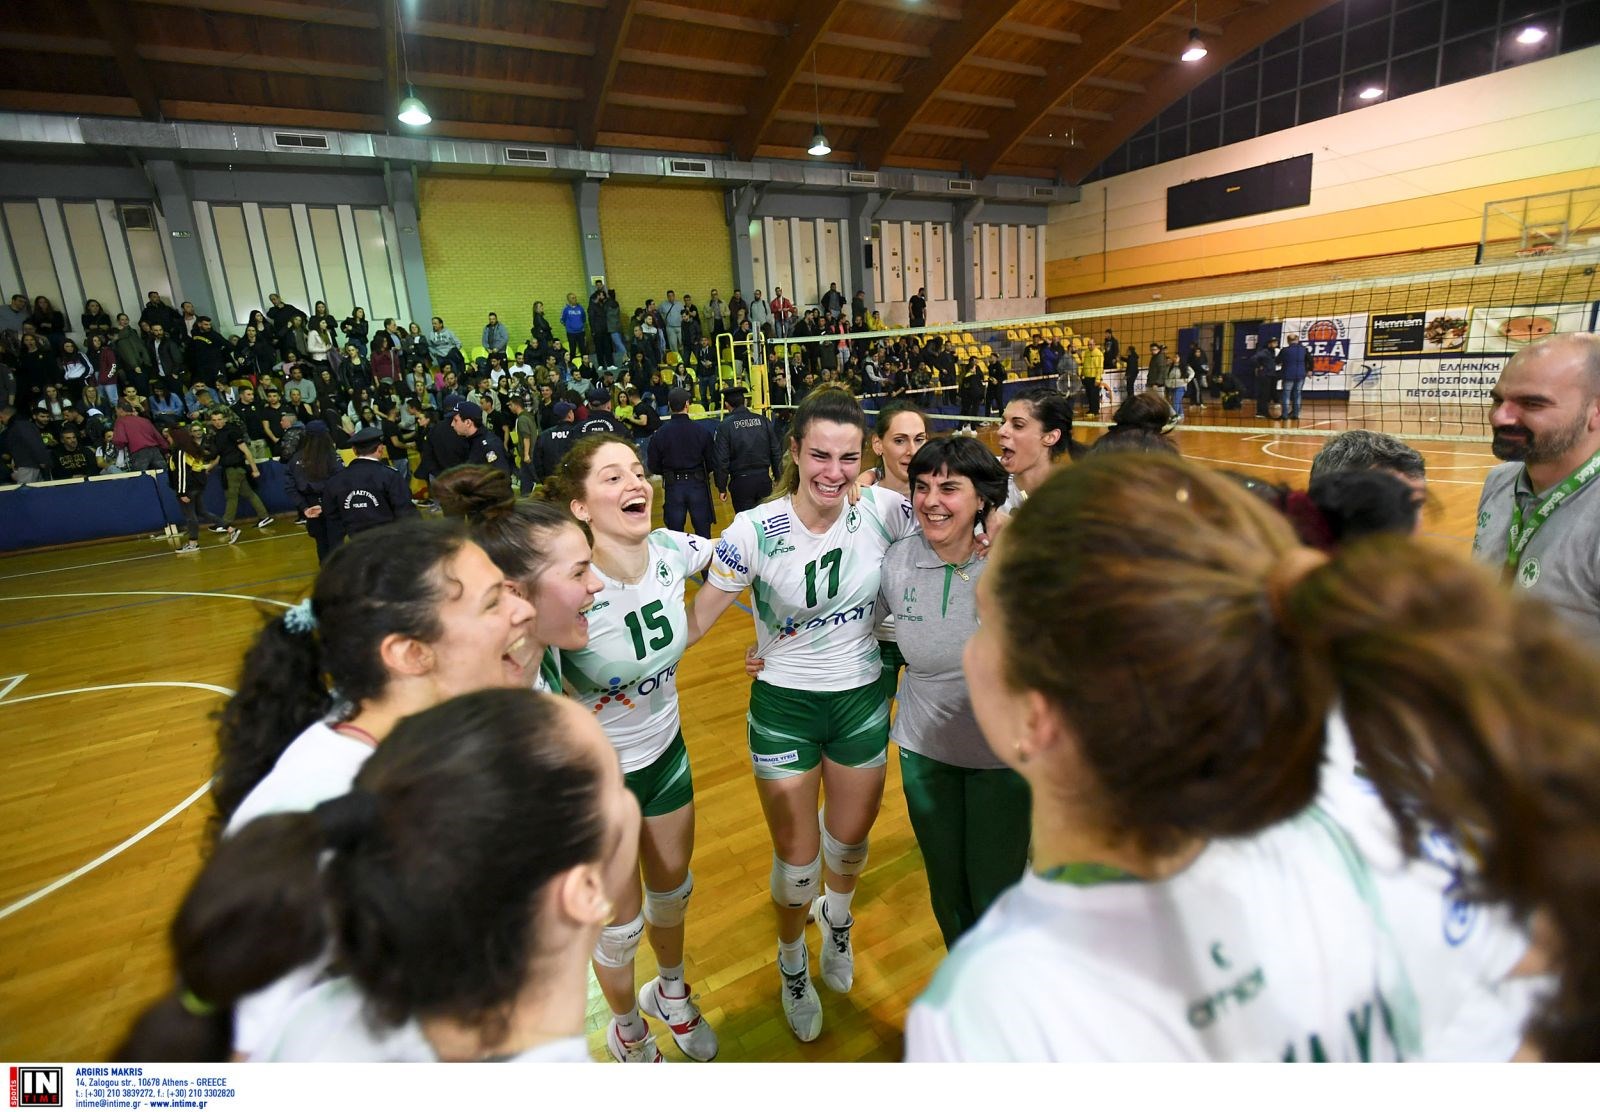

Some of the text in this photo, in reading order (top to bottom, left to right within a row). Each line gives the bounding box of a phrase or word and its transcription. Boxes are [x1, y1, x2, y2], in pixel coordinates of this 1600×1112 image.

[1374, 318, 1423, 329] Hammam
[1440, 363, 1500, 372] ΕΛΛΗΝΙΚΗ
[1421, 376, 1497, 385] ΟΜΟΣΠΟΝΔΙΑ
[733, 418, 762, 429] POLICE
[805, 547, 843, 608] 17
[624, 599, 674, 661] 15
